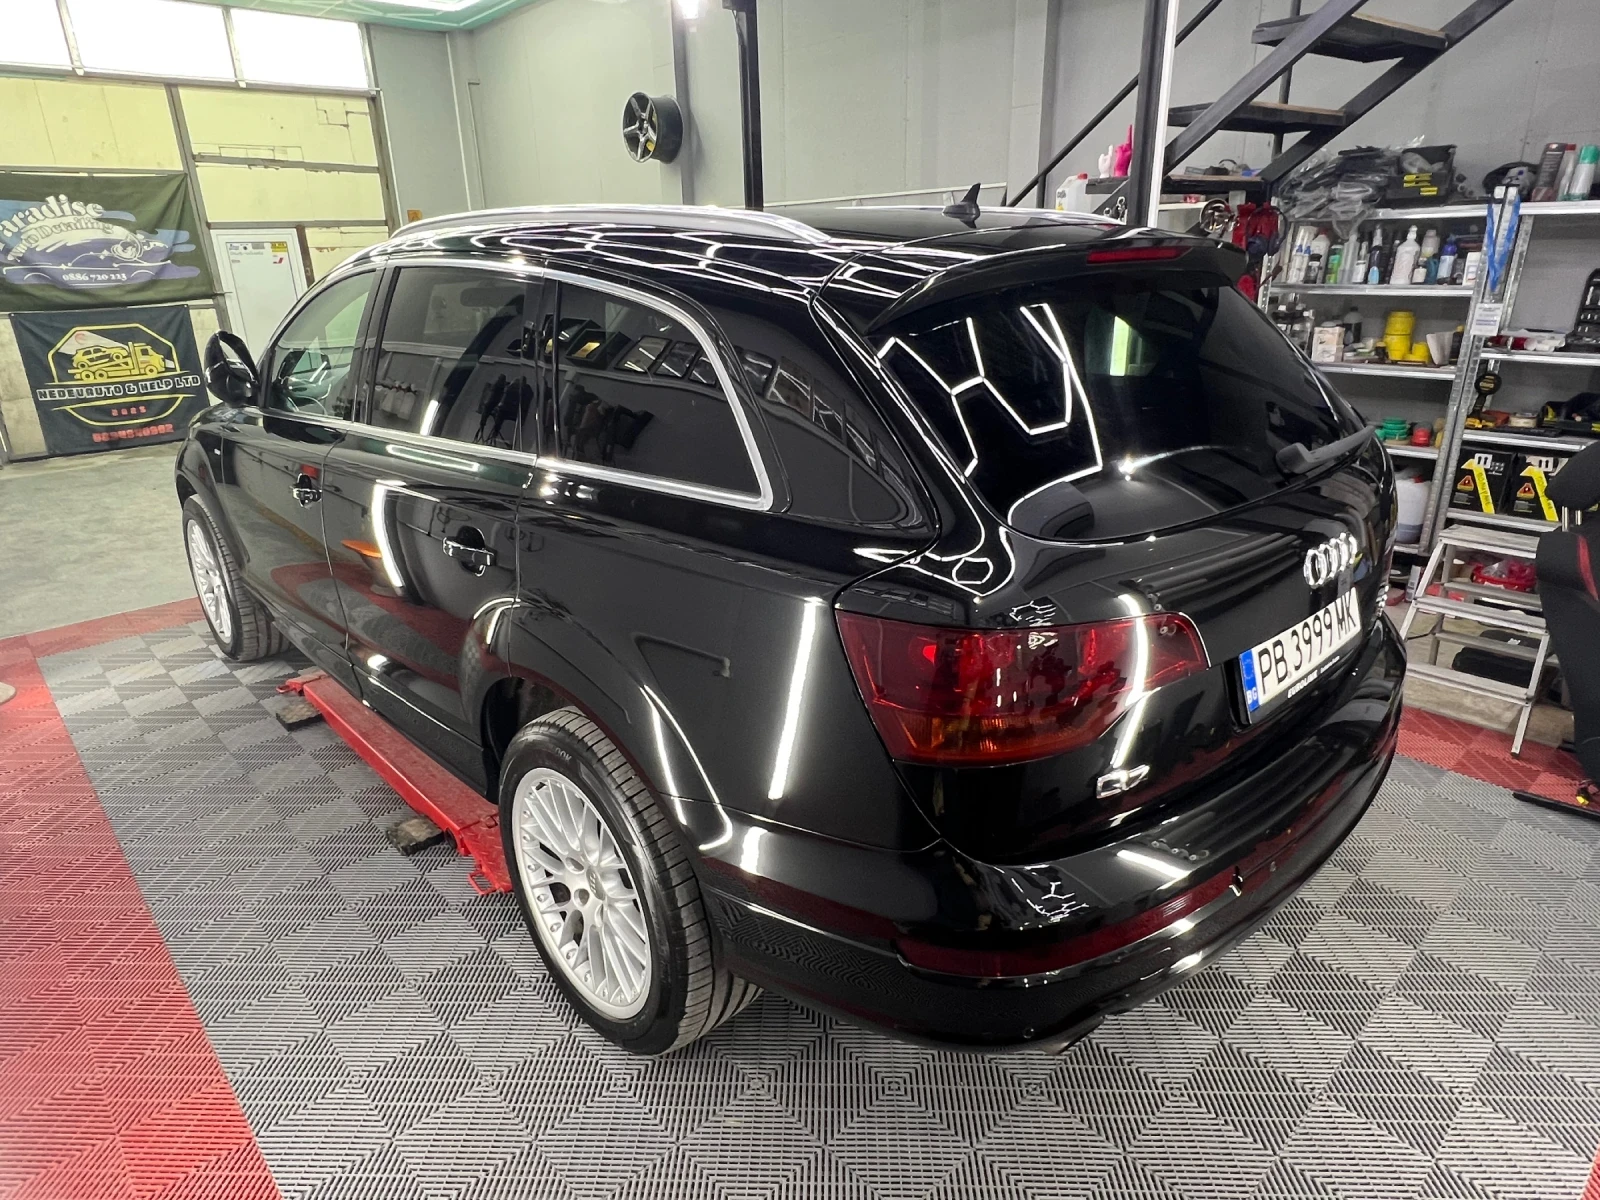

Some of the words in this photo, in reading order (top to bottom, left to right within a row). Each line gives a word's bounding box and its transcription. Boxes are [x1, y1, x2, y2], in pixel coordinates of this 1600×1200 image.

[0, 194, 105, 251] aradise
[36, 216, 115, 240] Detailing
[62, 272, 89, 281] 0886
[90, 273, 109, 282] 720
[125, 384, 137, 394] &
[139, 380, 173, 393] HELP
[175, 375, 201, 388] LTD
[1258, 639, 1288, 695] PB
[1290, 608, 1333, 672] 3999
[1334, 588, 1357, 641] MK
[1246, 686, 1258, 704] BG
